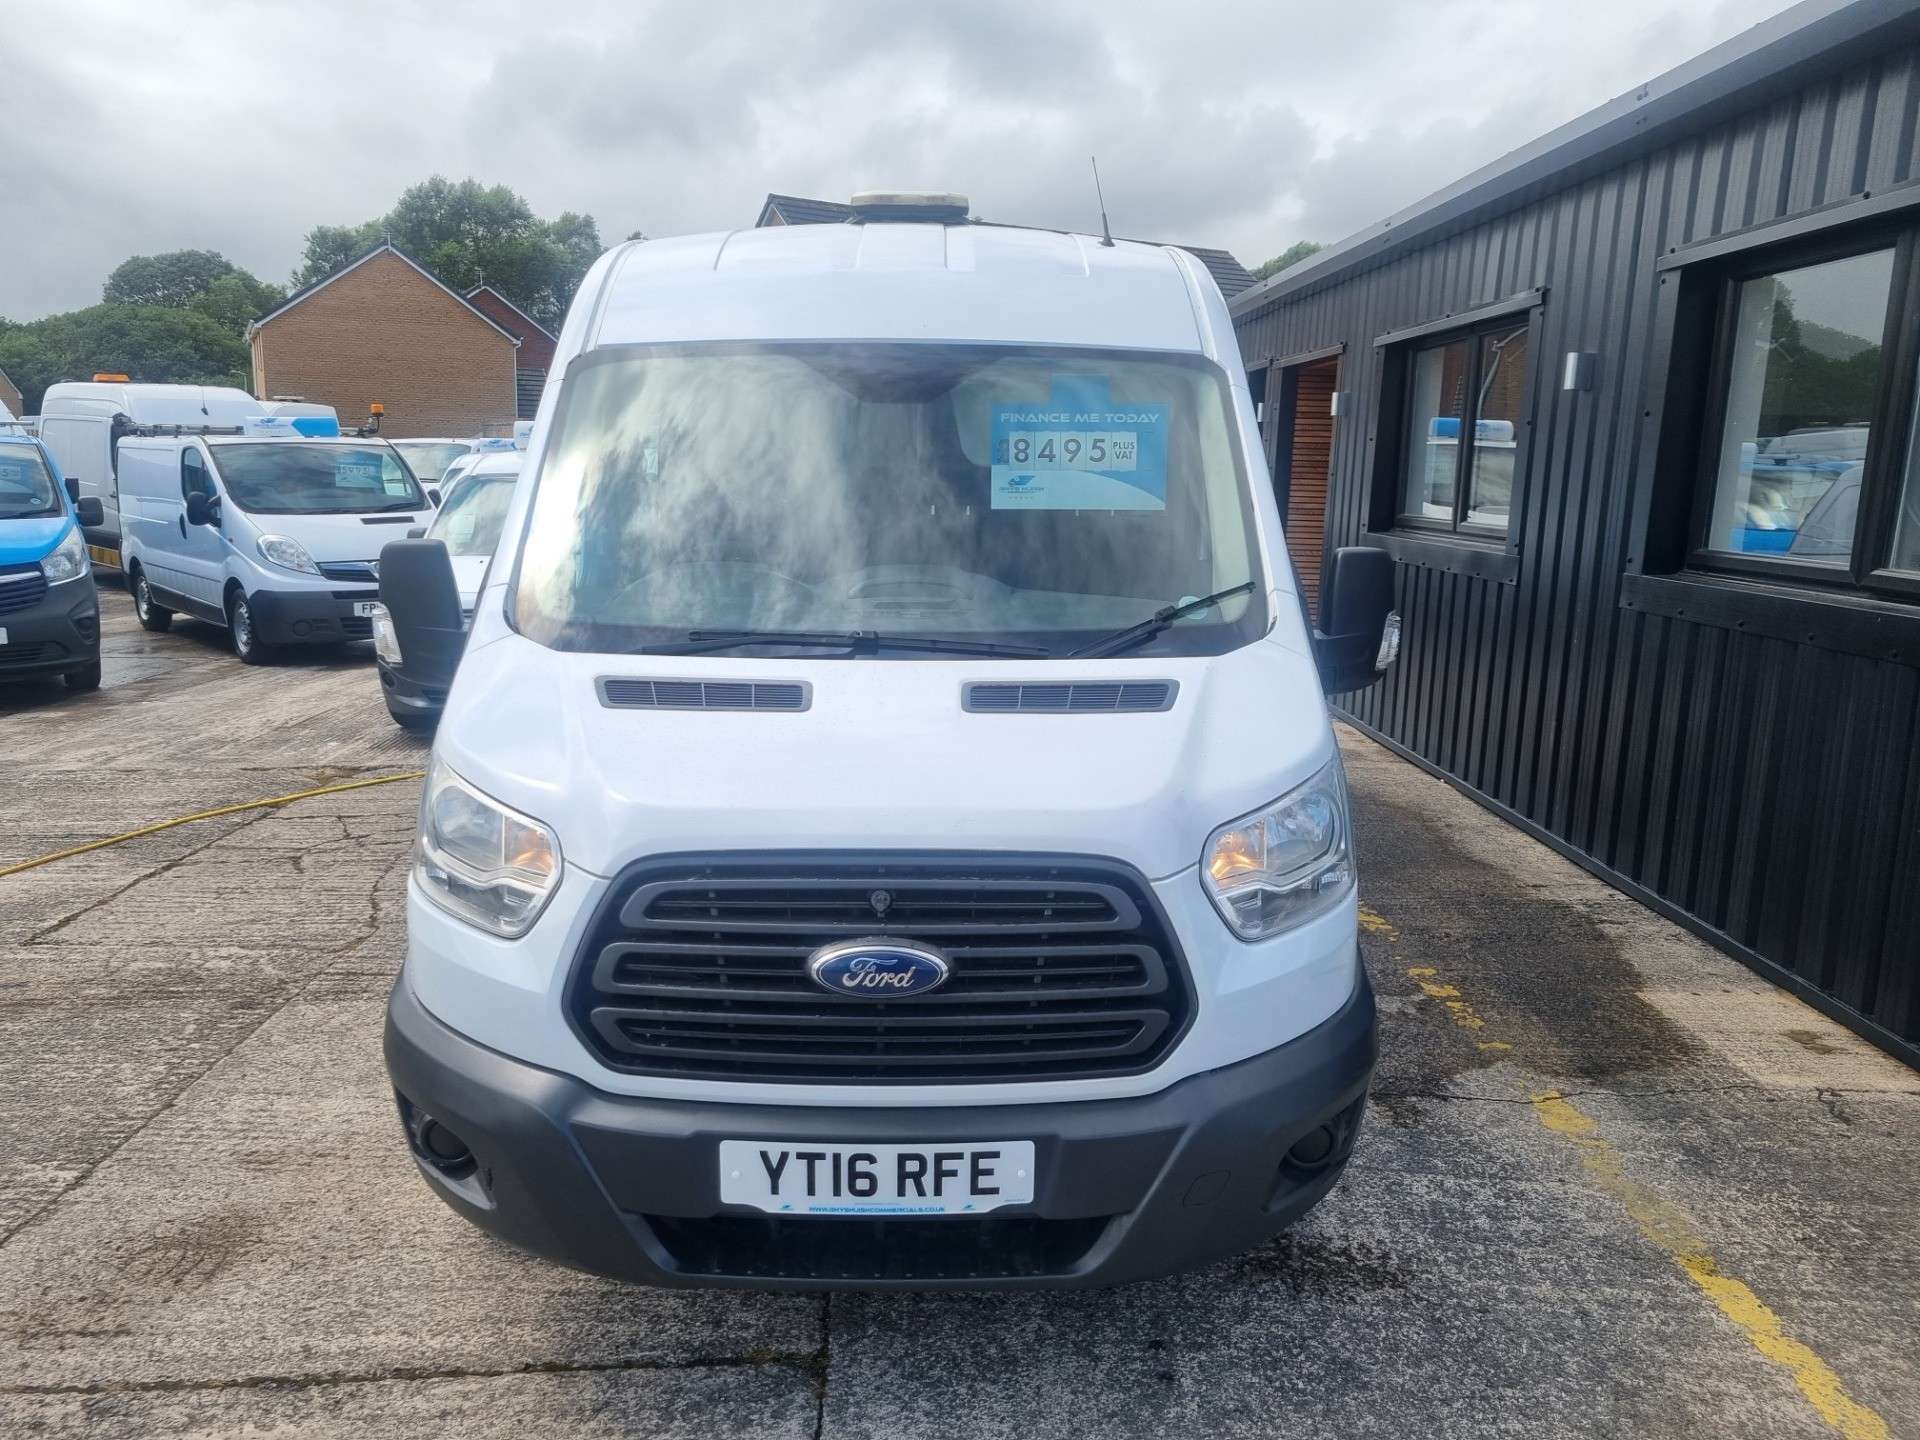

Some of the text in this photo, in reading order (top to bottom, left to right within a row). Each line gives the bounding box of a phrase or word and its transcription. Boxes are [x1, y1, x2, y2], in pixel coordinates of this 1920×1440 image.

[1000, 412, 1160, 423] FINANCE ME TODAY
[1112, 441, 1135, 451] PLUS
[1114, 451, 1133, 460] VAT
[842, 957, 916, 988] Ford
[759, 1150, 1001, 1198] YT16 RFE
